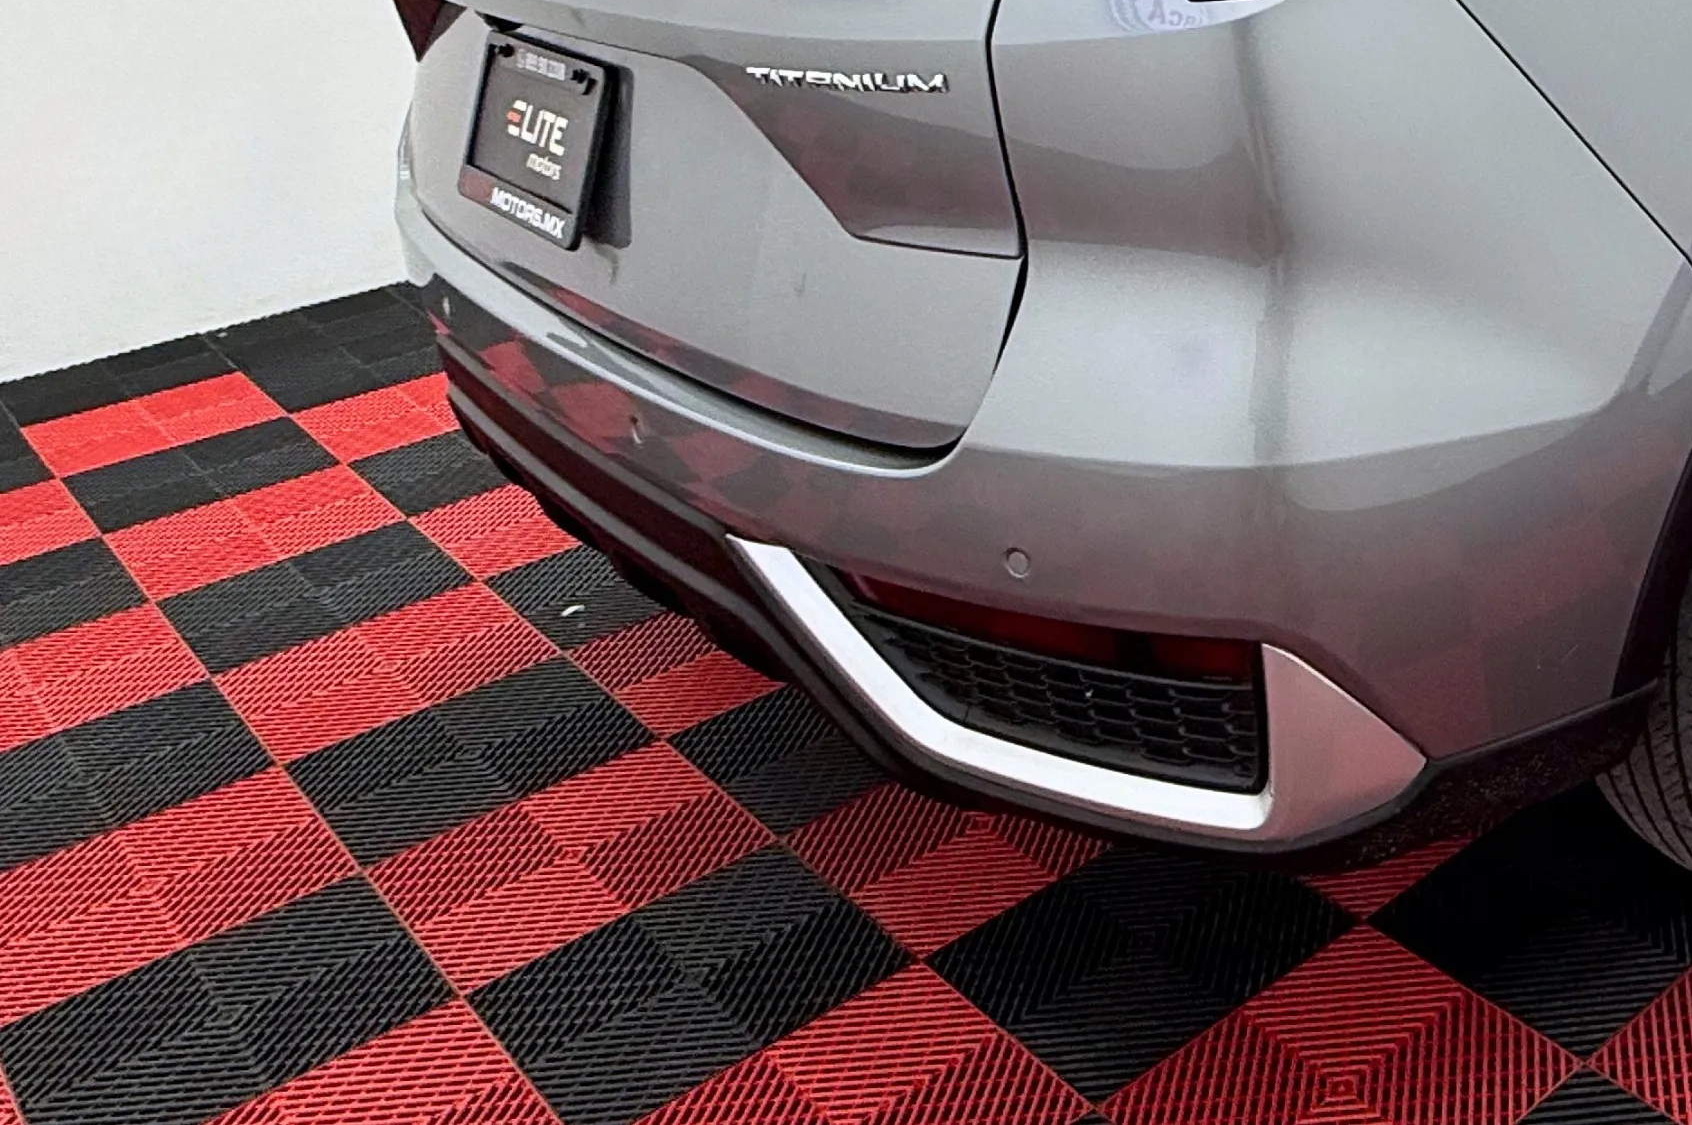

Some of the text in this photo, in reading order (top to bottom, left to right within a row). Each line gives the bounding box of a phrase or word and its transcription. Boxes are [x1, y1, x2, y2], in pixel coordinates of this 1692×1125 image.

[746, 66, 950, 94] TITANIUM
[506, 99, 569, 156] ELITE
[526, 153, 562, 181] motors
[490, 186, 565, 239] MOTORS.MX
